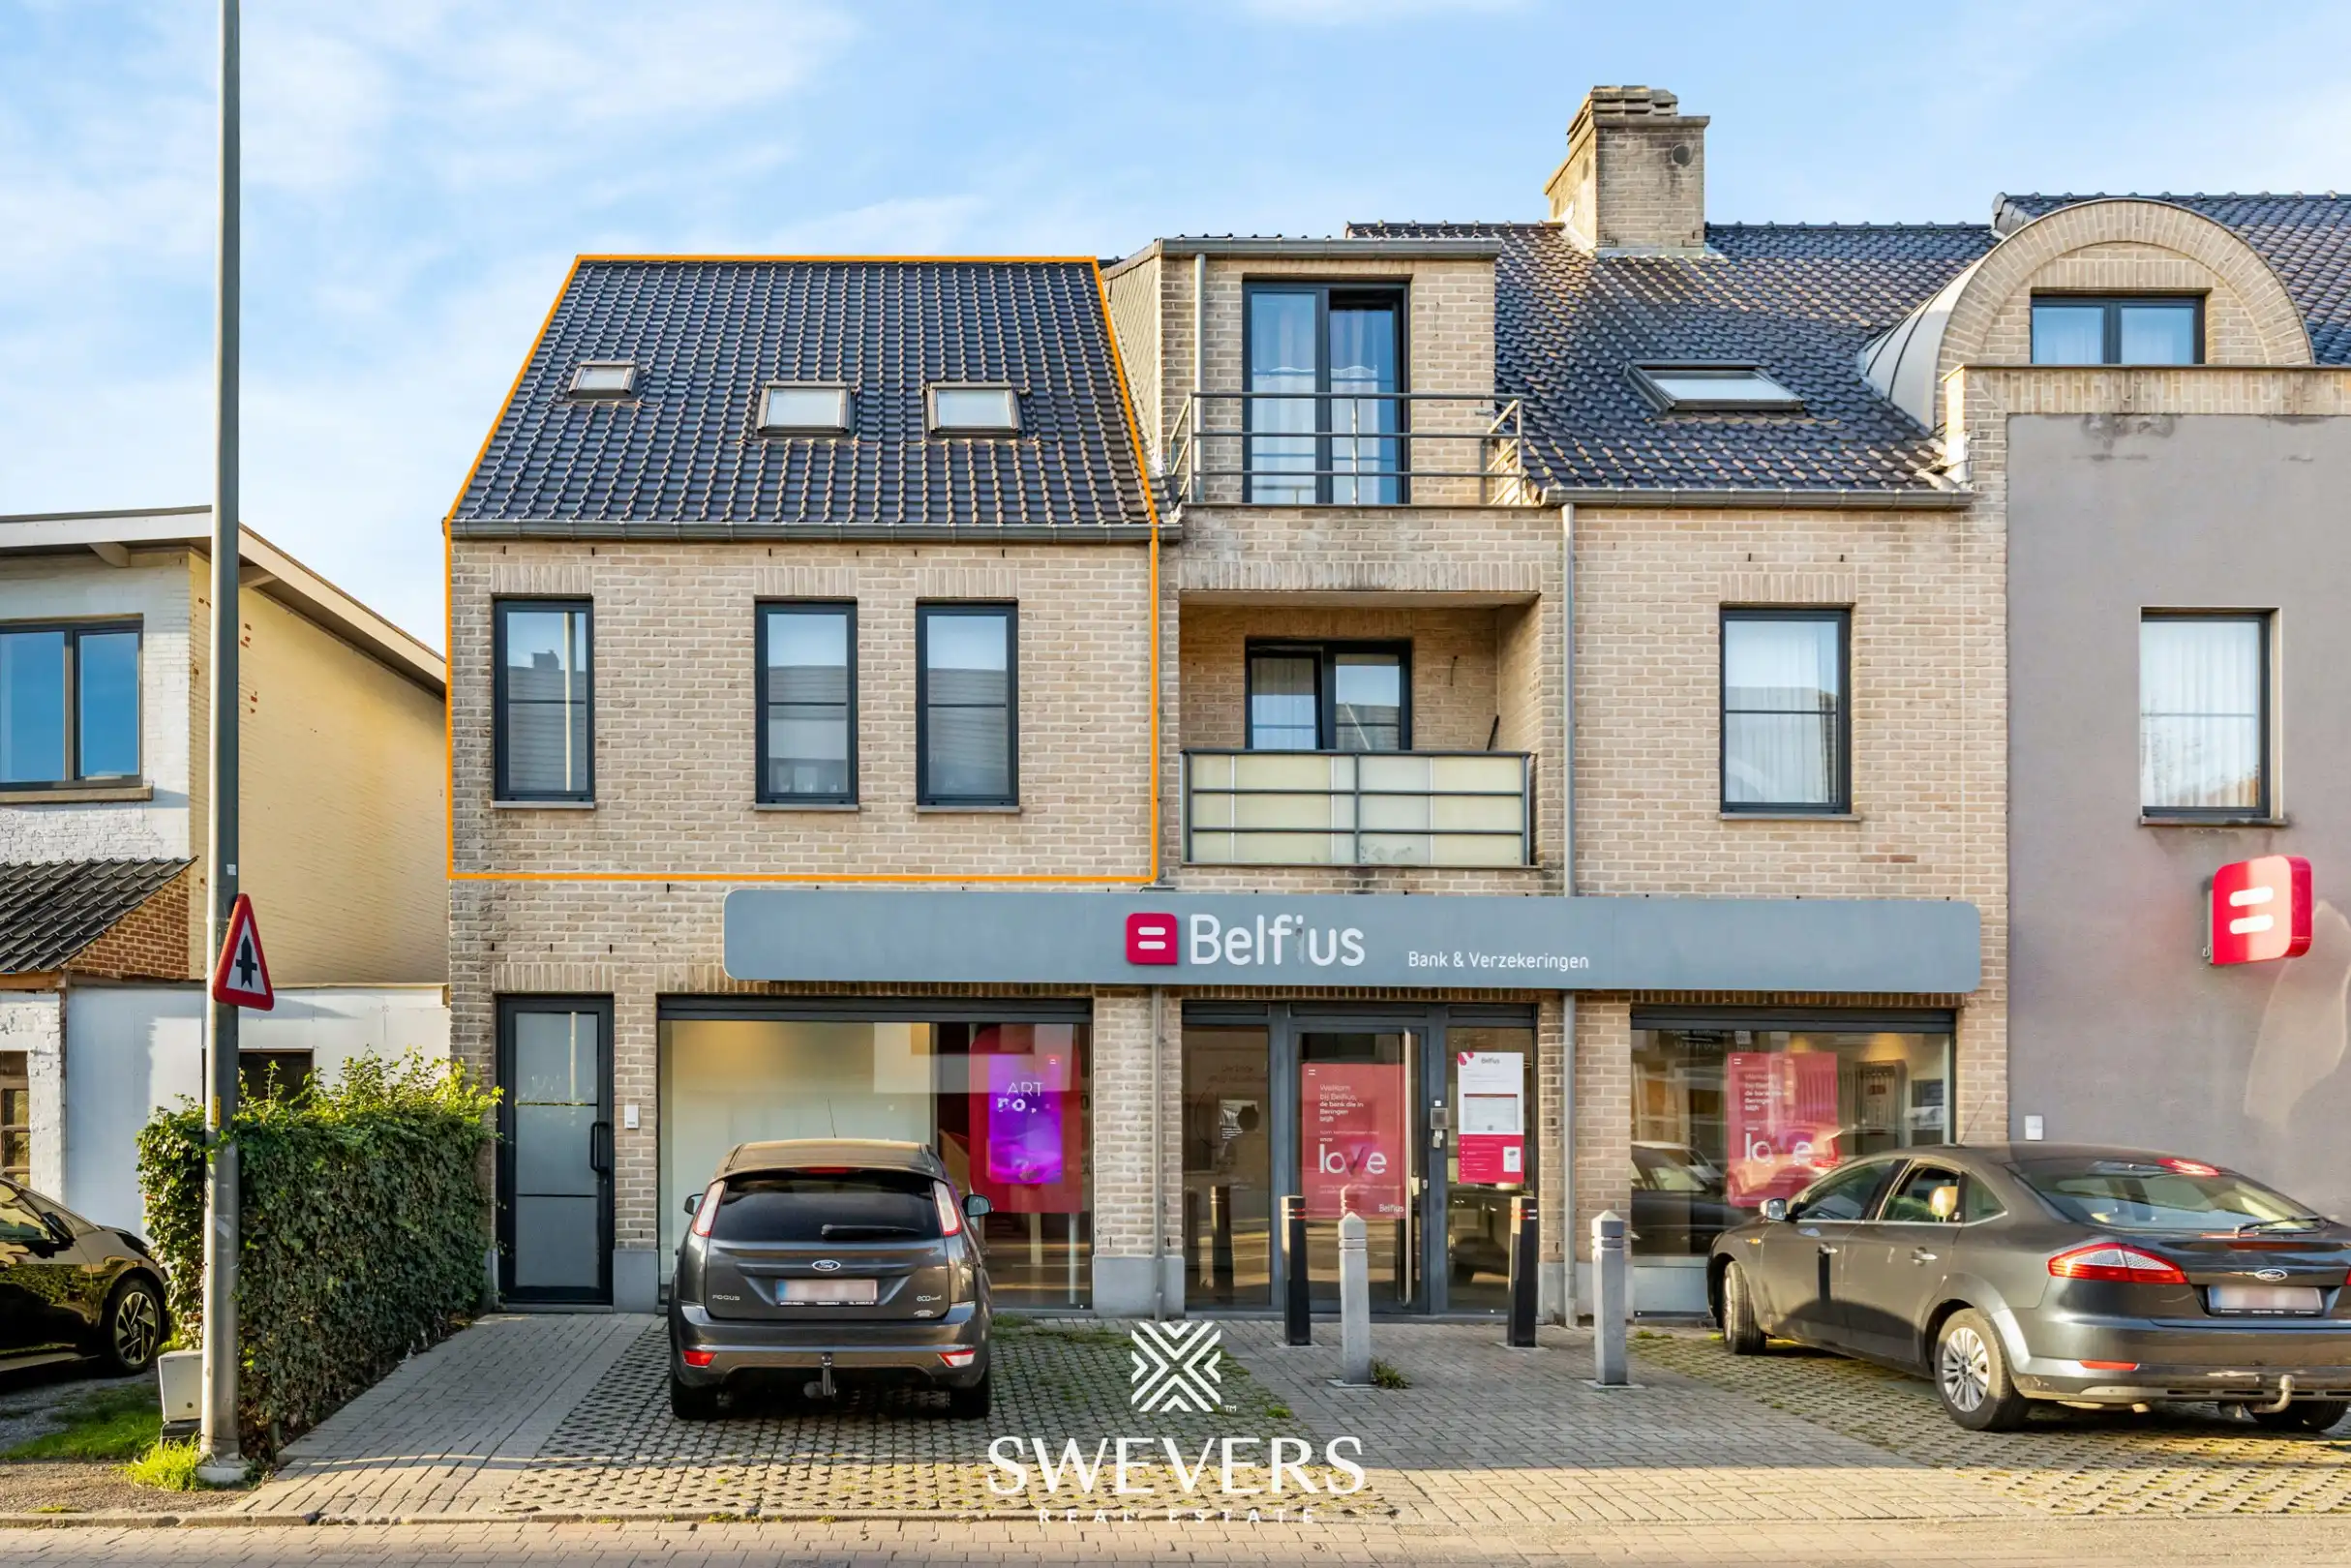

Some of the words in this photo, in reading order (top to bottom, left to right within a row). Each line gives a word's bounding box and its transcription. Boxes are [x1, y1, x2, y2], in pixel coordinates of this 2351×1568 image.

[1408, 950, 1448, 967] Bank
[1453, 950, 1464, 967] &
[1468, 951, 1589, 972] Verzekeringen
[1007, 1081, 1043, 1097] ART
[1378, 1203, 1405, 1213] Belfius
